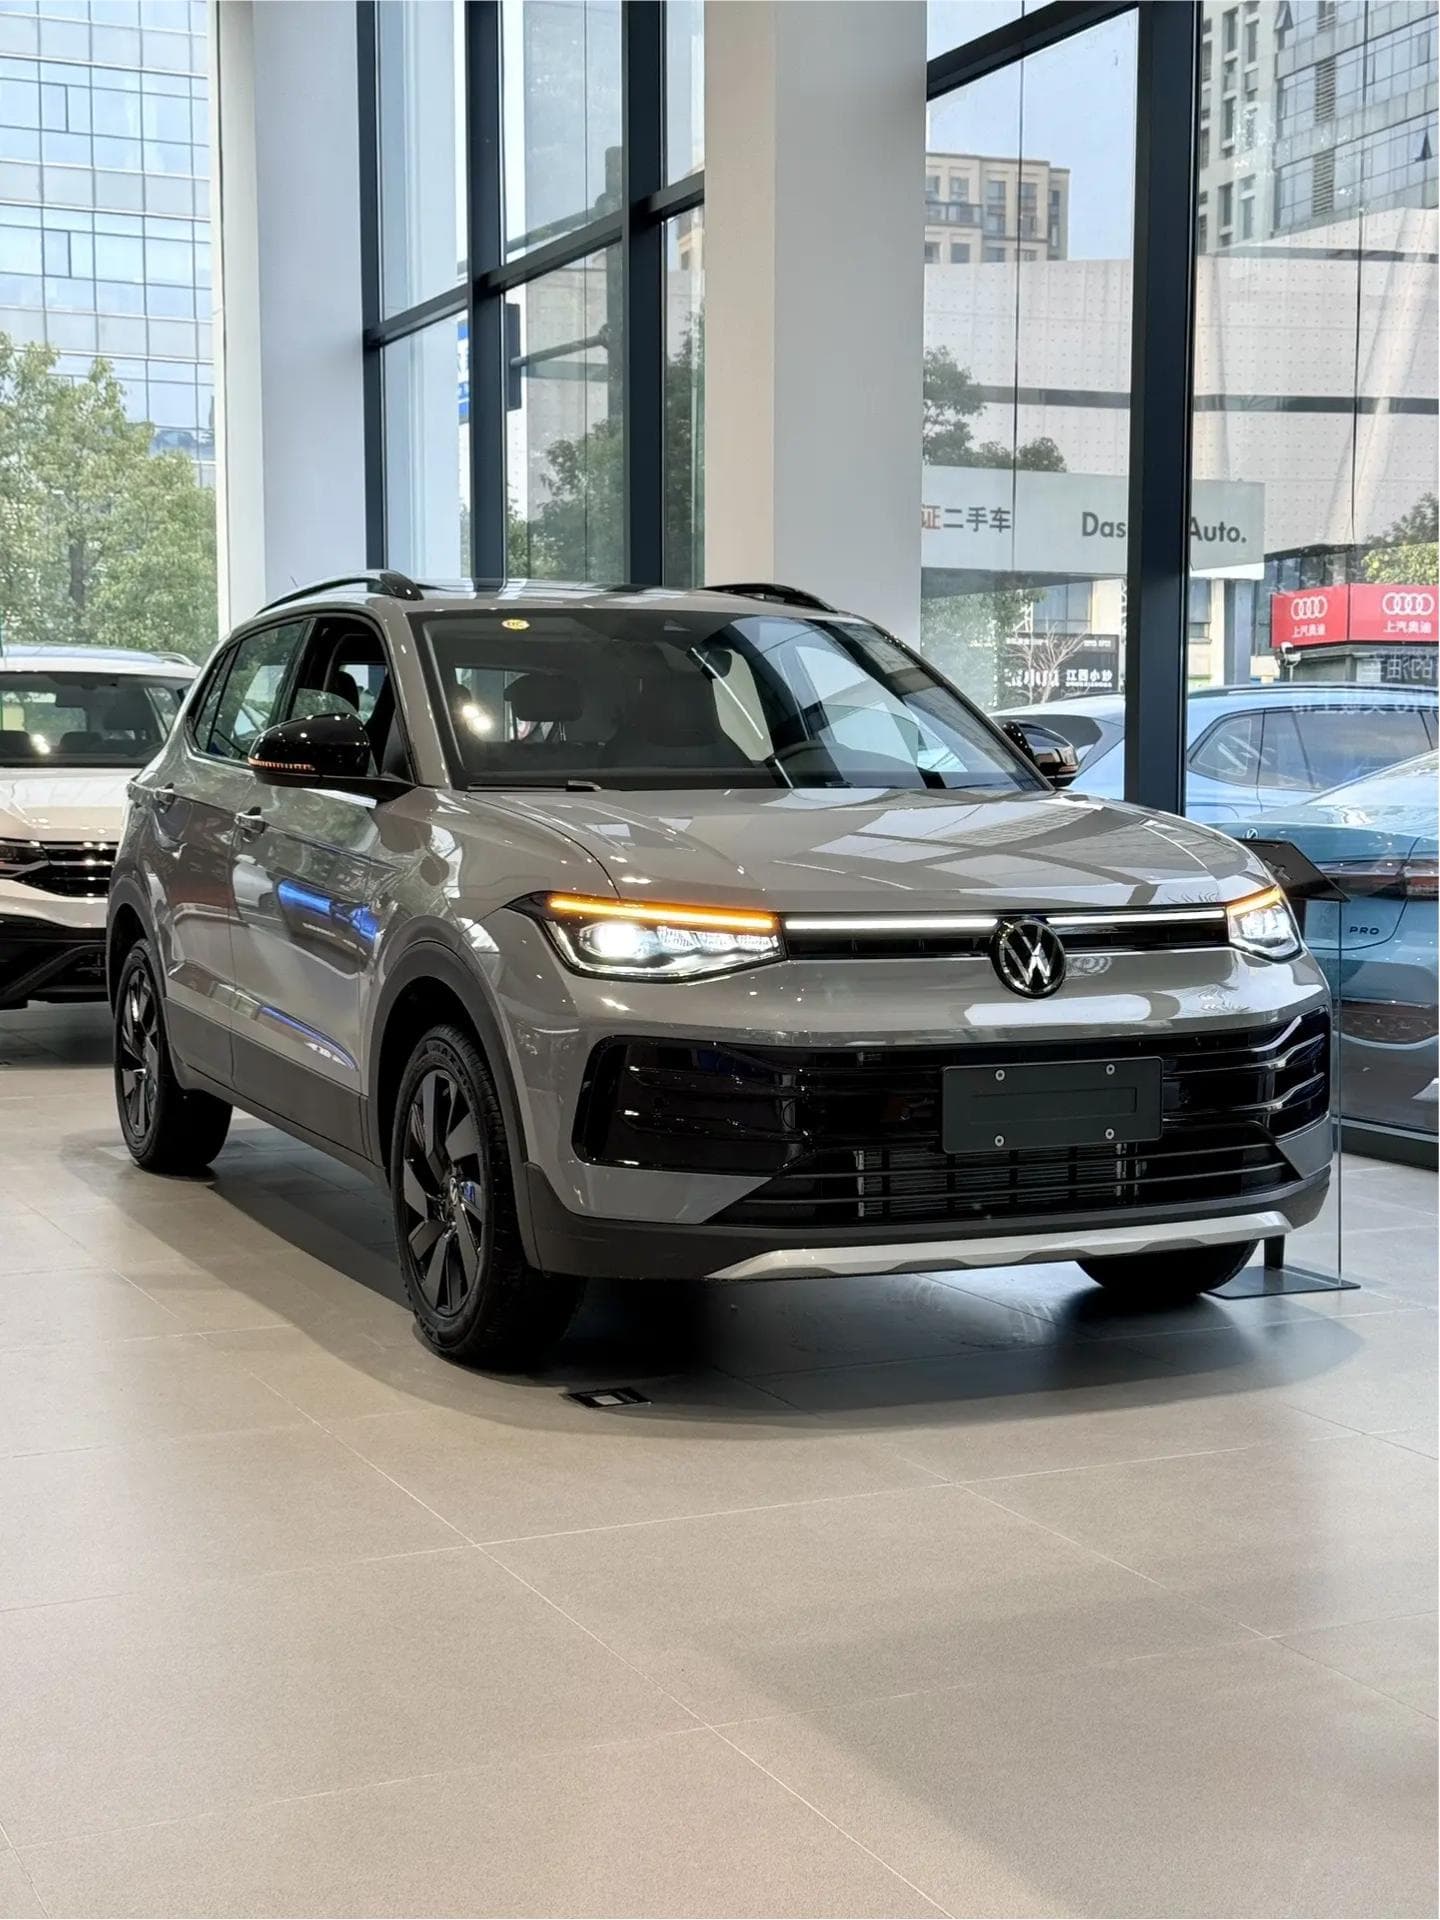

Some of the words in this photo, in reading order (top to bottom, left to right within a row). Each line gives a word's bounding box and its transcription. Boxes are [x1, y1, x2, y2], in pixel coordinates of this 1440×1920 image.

[921, 504, 1011, 533] 证二手车
[1082, 511, 1126, 538] Das
[1189, 516, 1247, 543] Auto.
[1291, 623, 1326, 639] 上汽奥迪
[1383, 620, 1432, 634] 上汽奥迪
[1349, 925, 1380, 935] PRO
